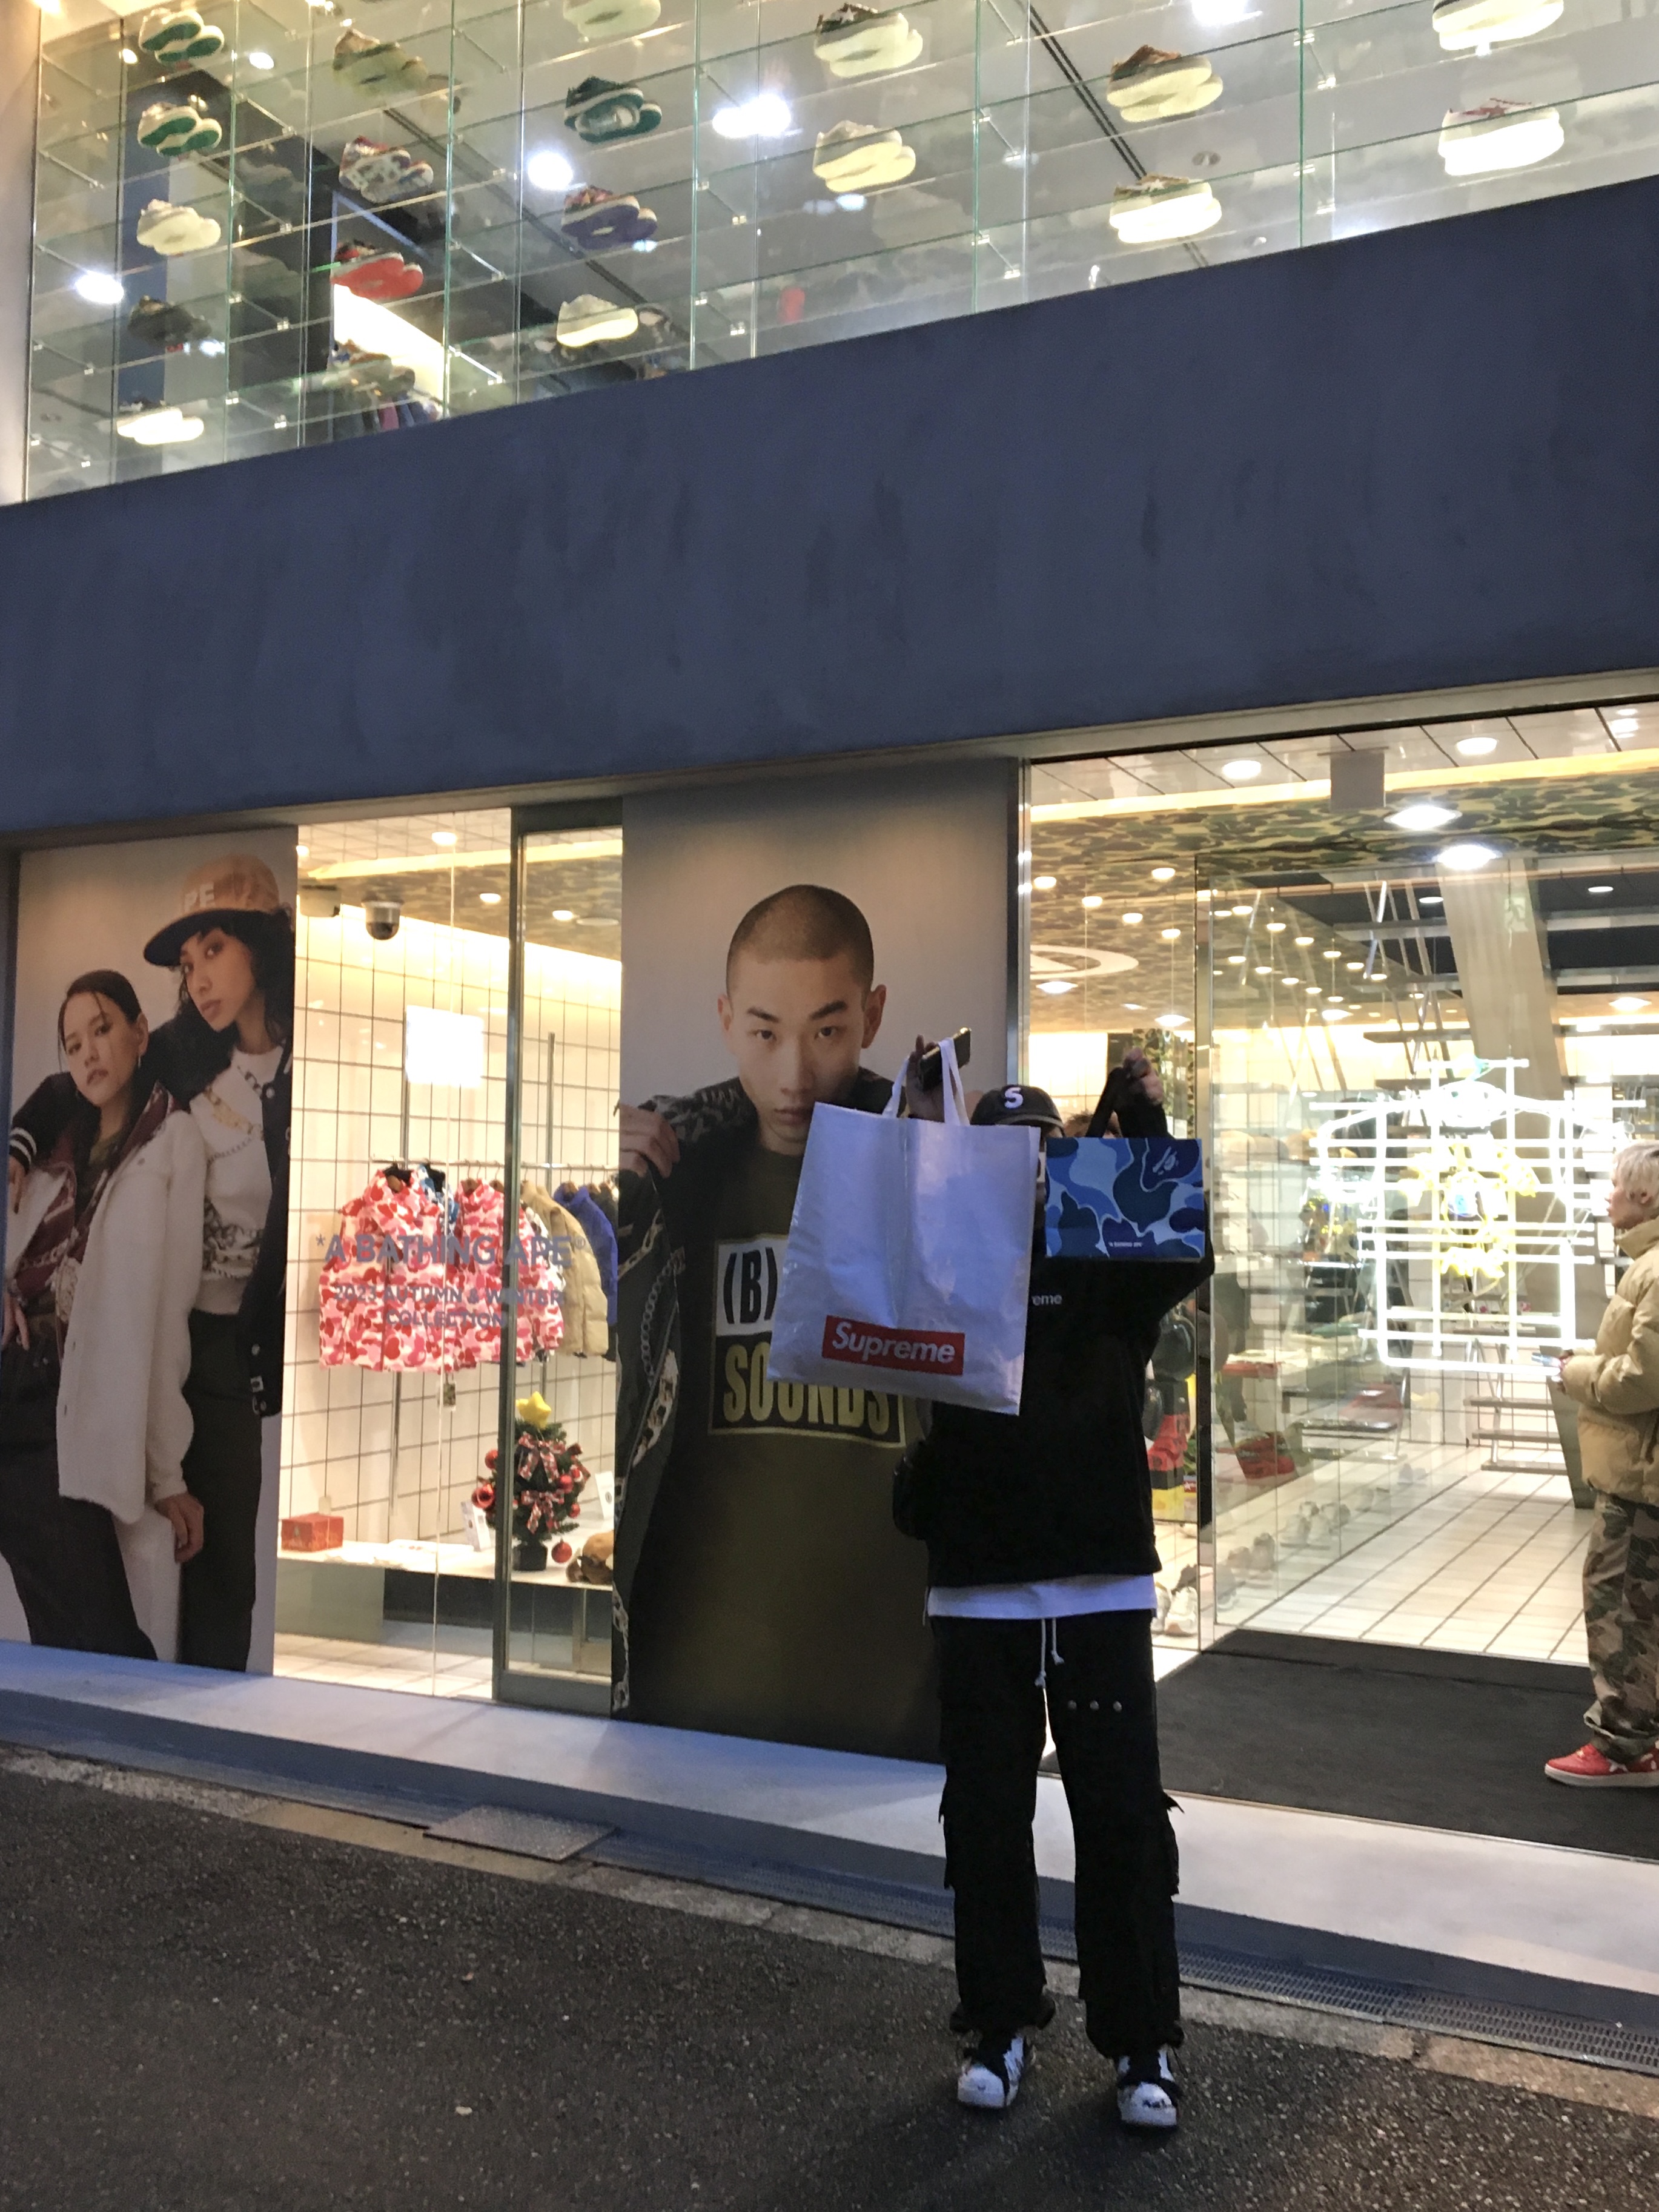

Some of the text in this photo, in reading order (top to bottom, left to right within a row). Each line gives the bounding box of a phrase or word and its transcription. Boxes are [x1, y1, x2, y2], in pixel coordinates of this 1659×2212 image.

[1004, 1086, 1024, 1109] S
[355, 1233, 496, 1265] BATHING
[334, 1285, 565, 1306] 2023 AUTUMN & WINTER
[386, 1309, 507, 1329] COLLECTION
[832, 1321, 955, 1363] Supreme
